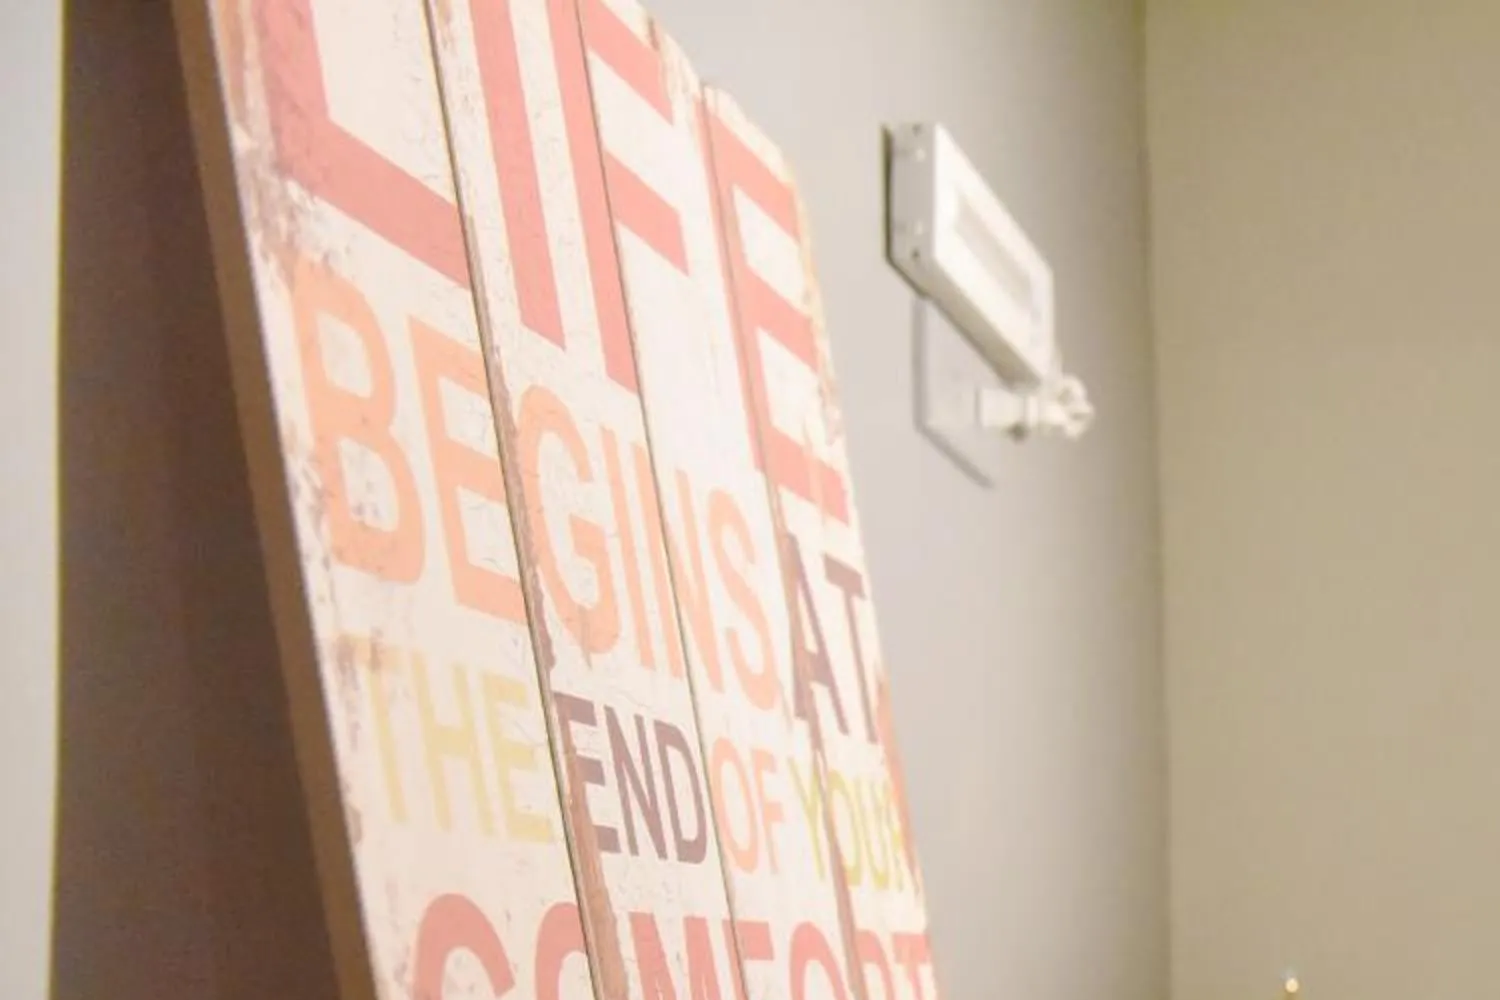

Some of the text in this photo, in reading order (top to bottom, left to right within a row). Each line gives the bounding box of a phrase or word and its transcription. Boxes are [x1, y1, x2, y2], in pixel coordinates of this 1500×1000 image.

[252, 0, 851, 527] LIFE
[288, 248, 879, 745] BEGINS AT
[332, 633, 920, 892] THE END OF YOUR
